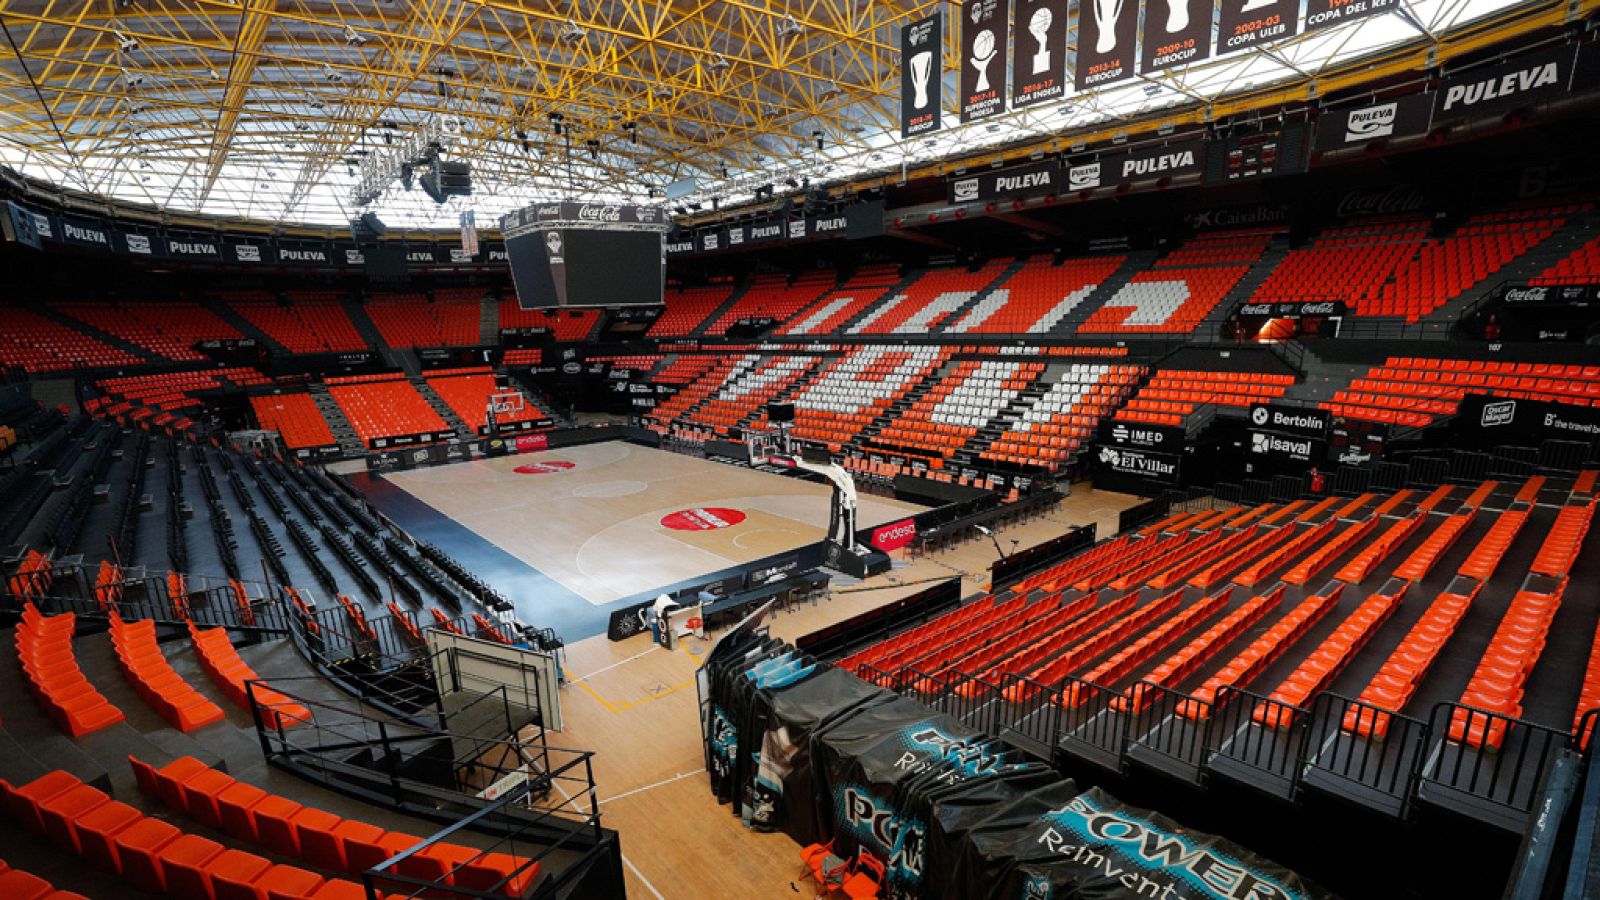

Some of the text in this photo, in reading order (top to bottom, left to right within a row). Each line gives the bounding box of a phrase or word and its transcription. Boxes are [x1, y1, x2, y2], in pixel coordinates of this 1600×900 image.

[1308, 10, 1341, 25] COPA
[1345, 3, 1367, 15] DEL
[1235, 14, 1281, 35] 2002-03
[1227, 24, 1286, 47] COPA ULEB
[1156, 39, 1195, 56] 2009-10
[1152, 48, 1197, 66] EUROCUP
[1085, 67, 1123, 84] EUROCUP
[1015, 86, 1062, 104] LIGA ENDESA
[1443, 62, 1558, 110] PULEVA
[1351, 108, 1394, 124] PULEVA
[1071, 165, 1099, 178] PULEVA
[1122, 151, 1195, 177] PULEVA
[995, 172, 1051, 192] PULEVA
[64, 224, 107, 243] PULEVA
[751, 225, 781, 239] PULEVA
[169, 241, 217, 255] PULEVA
[280, 249, 326, 261] PULEVA
[406, 252, 434, 261] LEVA
[1274, 411, 1323, 429] Bertolín
[1131, 429, 1163, 442] IMED
[1269, 435, 1312, 455] isaval
[1121, 457, 1135, 468] El
[1138, 458, 1176, 474] Villar
[879, 523, 916, 543] endesa
[1037, 826, 1187, 900] Reinvent
